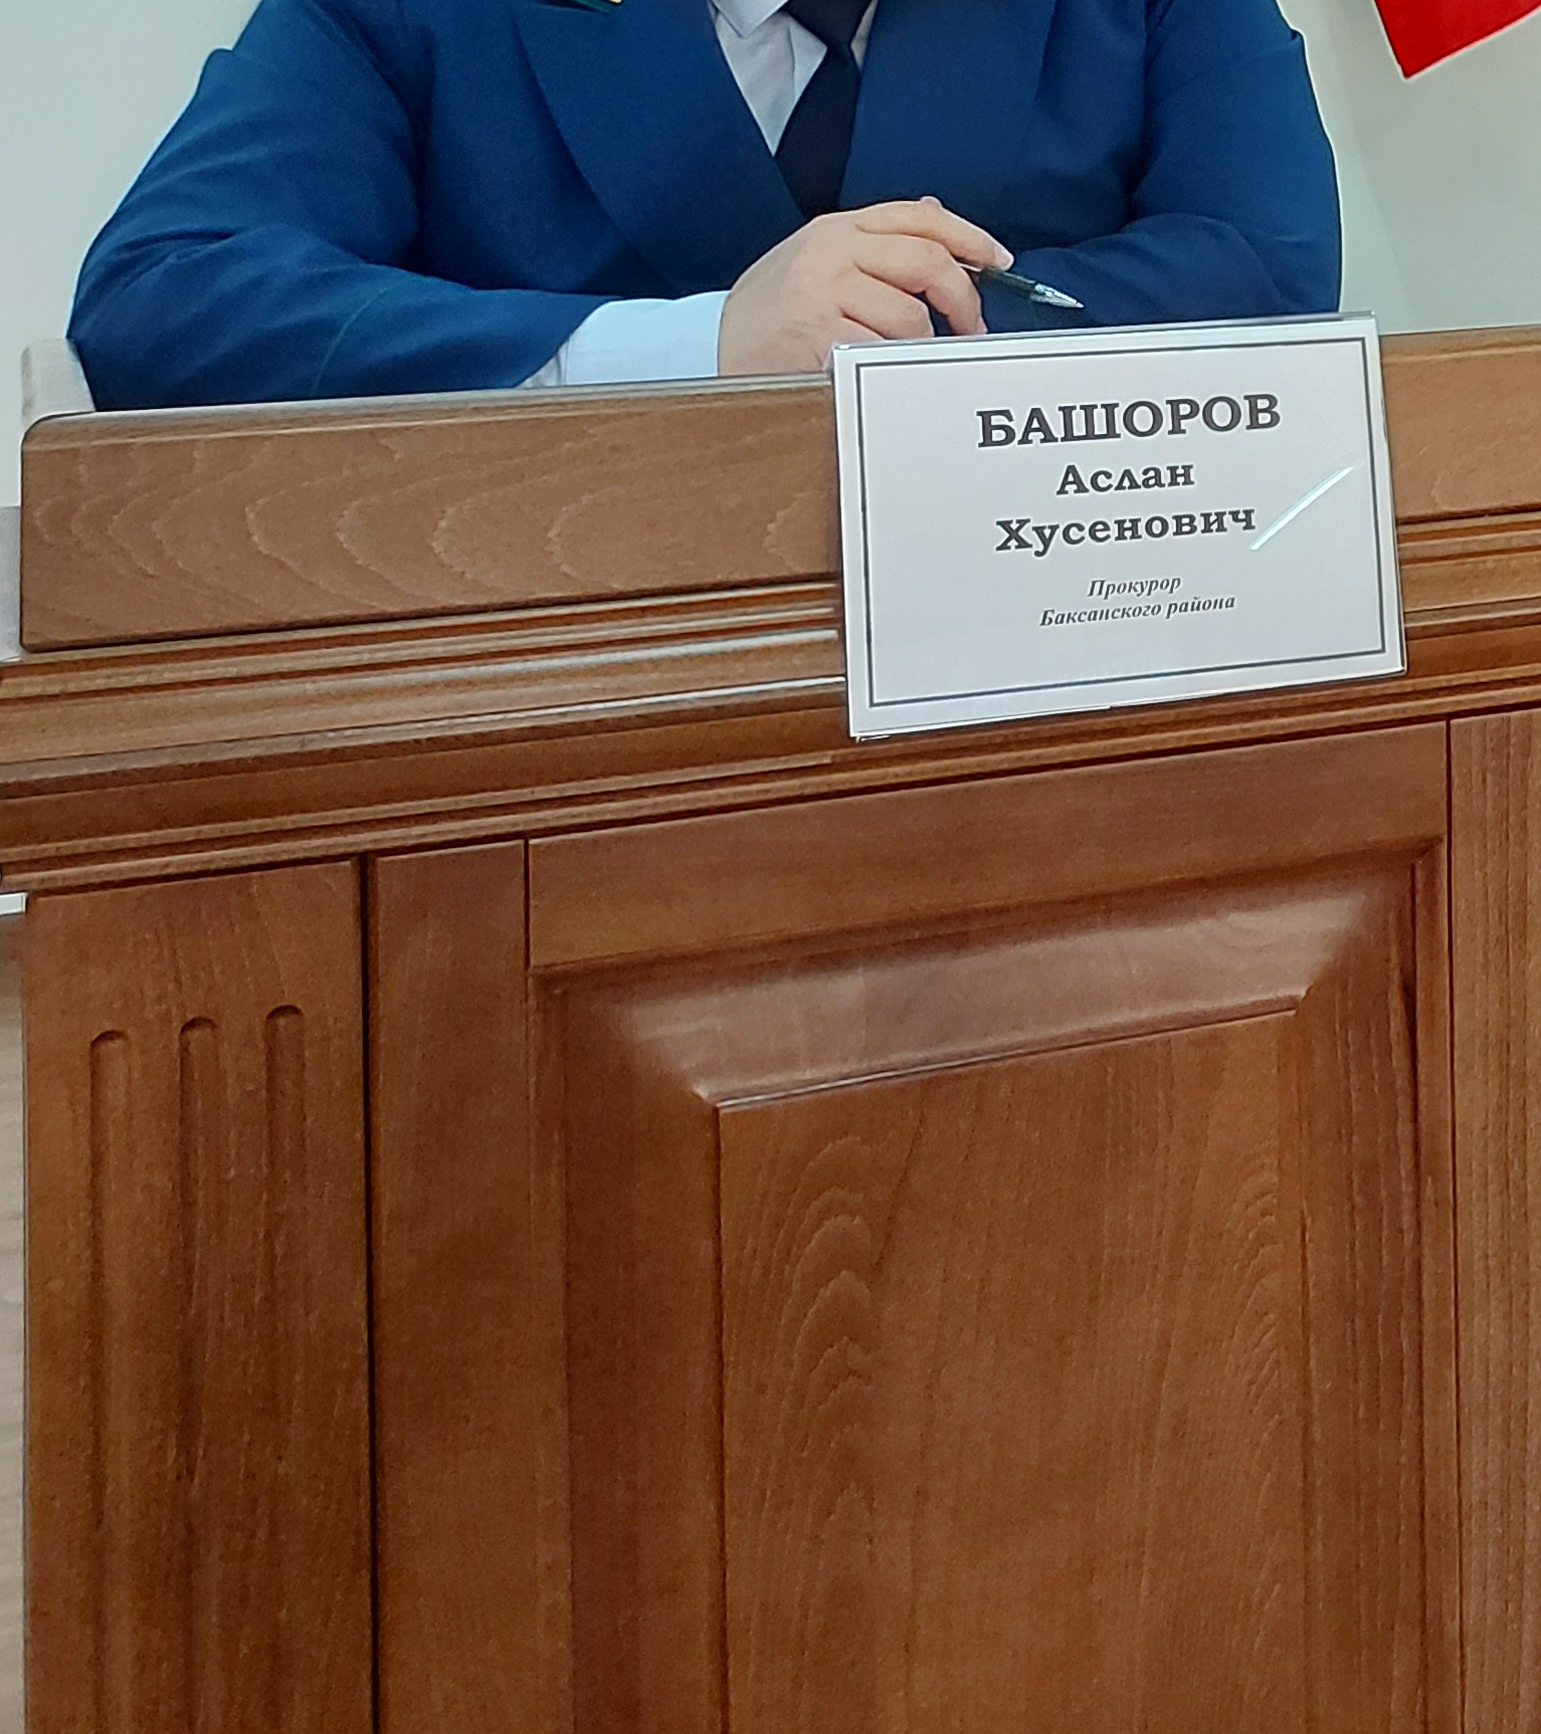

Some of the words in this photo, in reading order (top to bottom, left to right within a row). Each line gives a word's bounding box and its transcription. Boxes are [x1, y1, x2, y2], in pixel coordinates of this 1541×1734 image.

[975, 392, 1282, 448] БАШОРОВ
[1055, 463, 1195, 495] Аслан
[995, 508, 1256, 557] Хусенович
[1087, 574, 1183, 599] Прокурор
[1039, 602, 1162, 628] Баксанского
[1165, 594, 1236, 622] района
